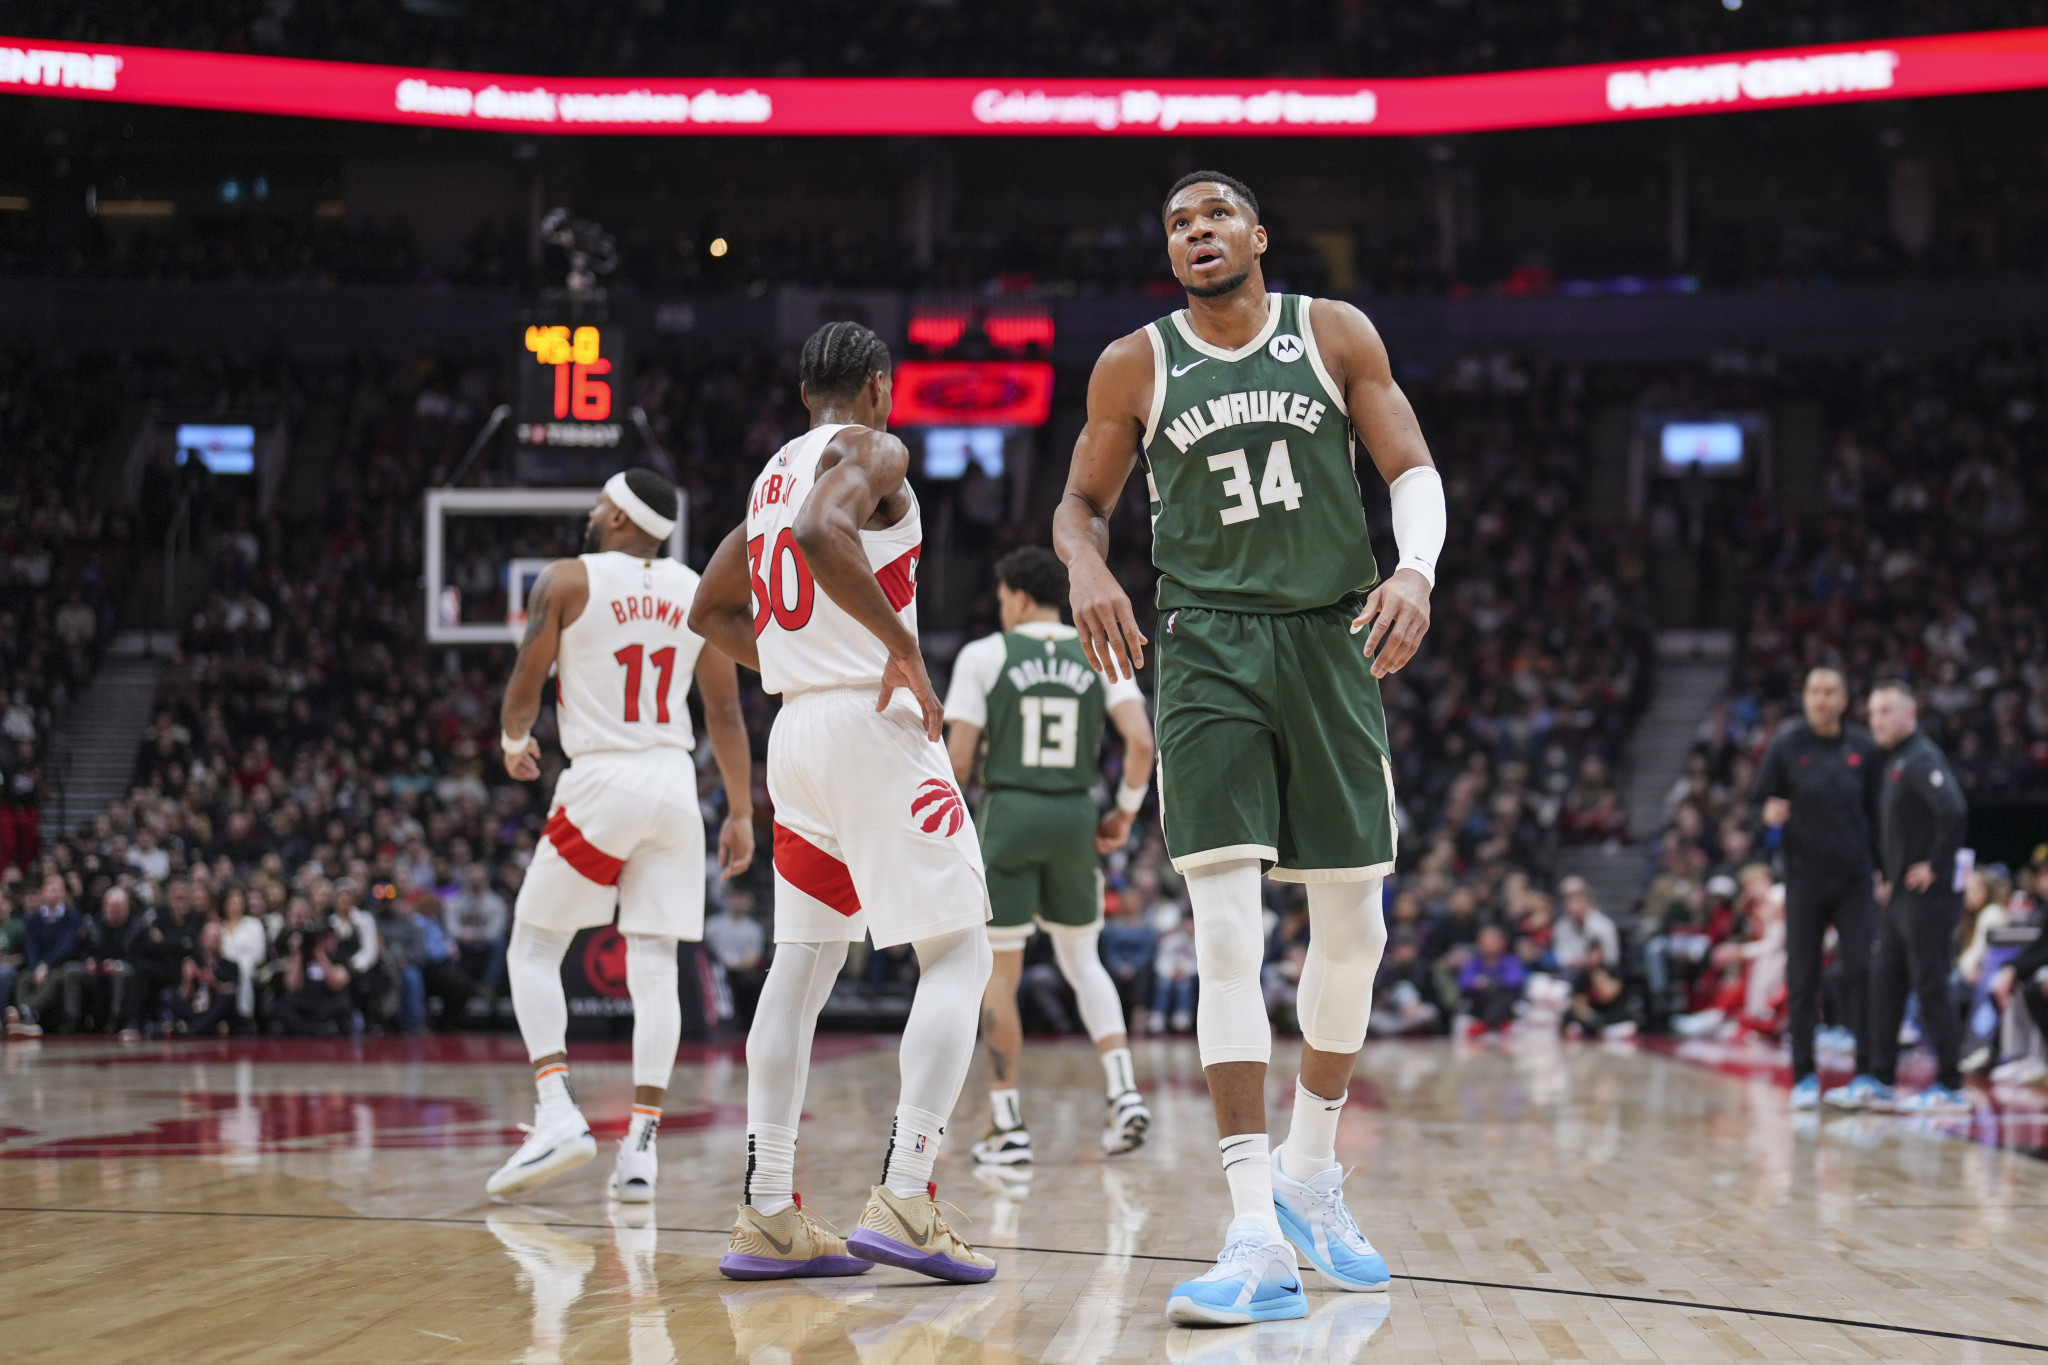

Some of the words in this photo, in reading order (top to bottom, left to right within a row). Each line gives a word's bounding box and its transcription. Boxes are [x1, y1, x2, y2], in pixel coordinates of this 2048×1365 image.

[972, 88, 1120, 131] Celebrating
[1159, 94, 1243, 131] years
[1244, 89, 1283, 124] of
[1282, 89, 1376, 124] travel
[1607, 62, 1742, 111] FLIGHT
[1742, 49, 1896, 100] CENTRE
[554, 357, 612, 420] 16
[547, 422, 622, 447] TISSOT
[1163, 390, 1327, 455] MILWAUKEE
[1206, 439, 1303, 526] 34
[611, 595, 685, 630] BROWN
[747, 526, 815, 640] 30
[614, 643, 677, 724] 11
[1007, 656, 1096, 695] ROLLINS
[1020, 696, 1079, 768] 13
